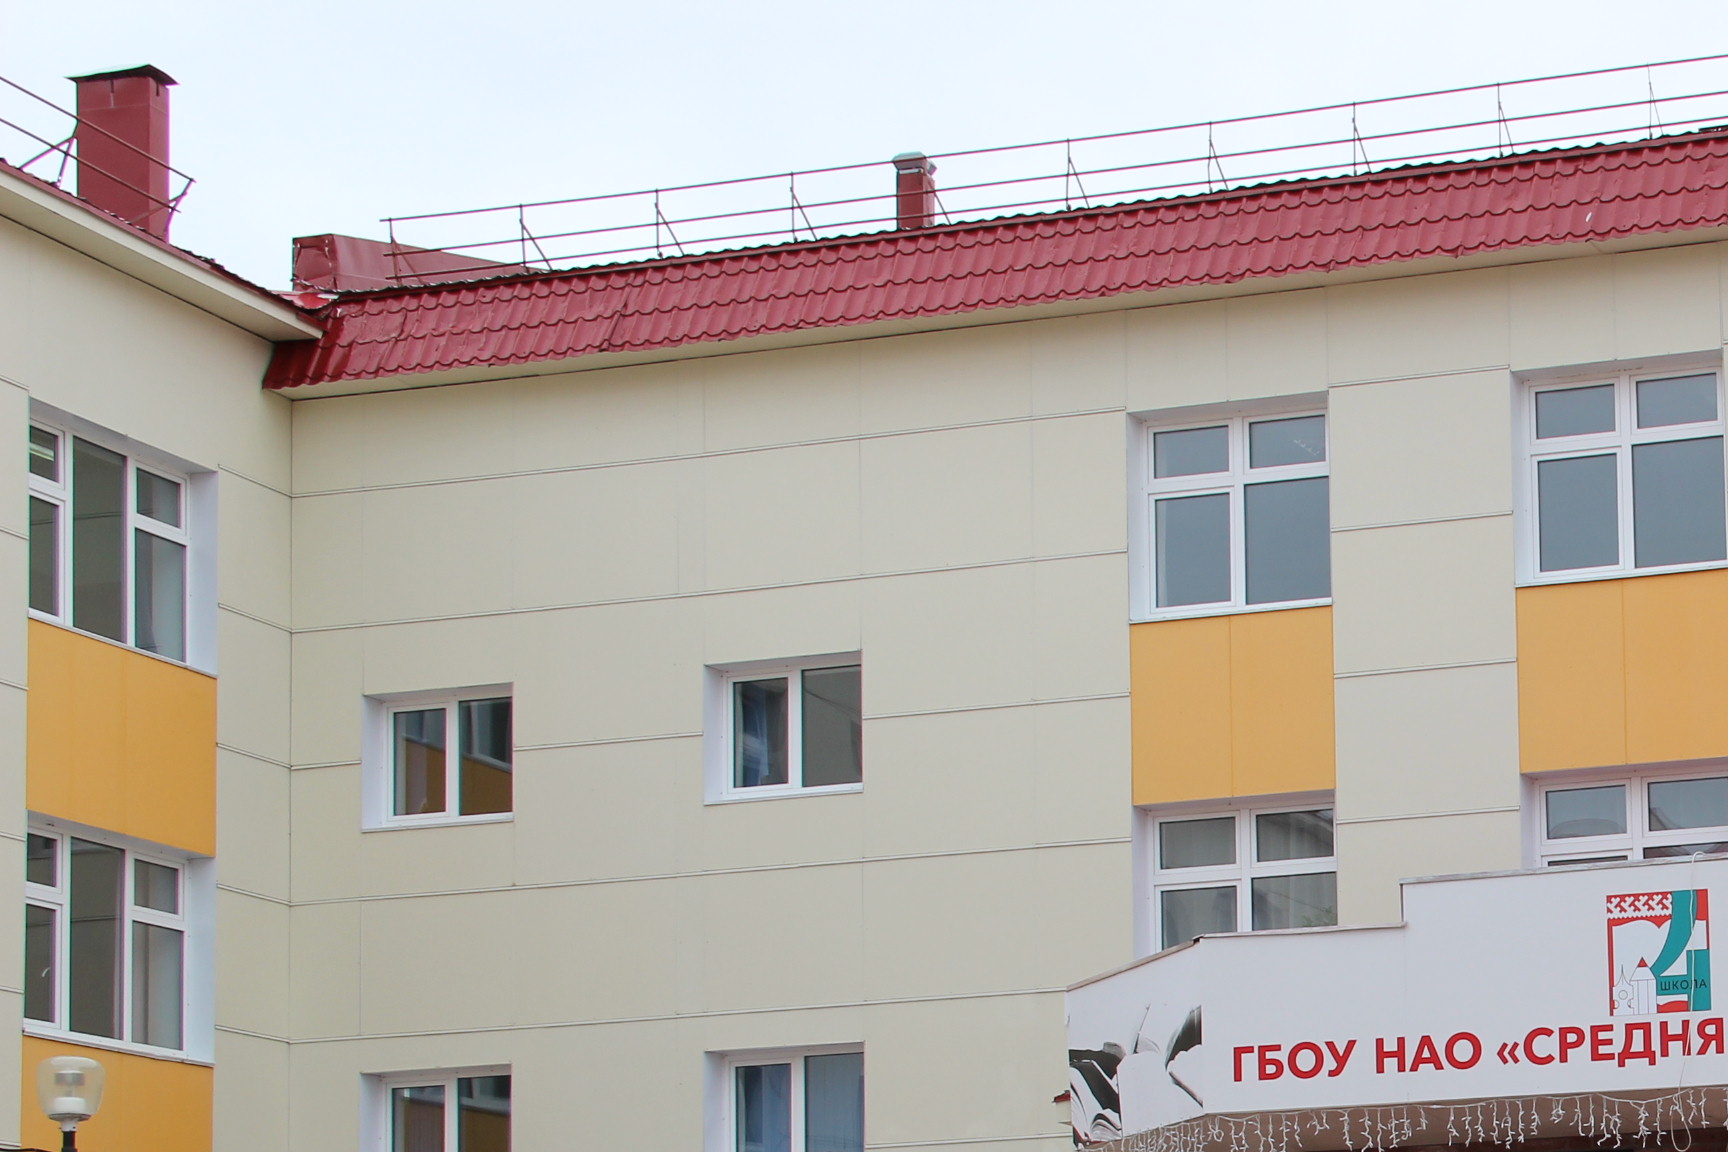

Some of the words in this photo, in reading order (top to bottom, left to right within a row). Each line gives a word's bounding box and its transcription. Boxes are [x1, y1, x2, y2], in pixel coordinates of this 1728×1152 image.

[1660, 979, 1707, 991] ШКОЛА
[1235, 1040, 1356, 1081] ГБОУ
[1376, 1032, 1482, 1074] НАО
